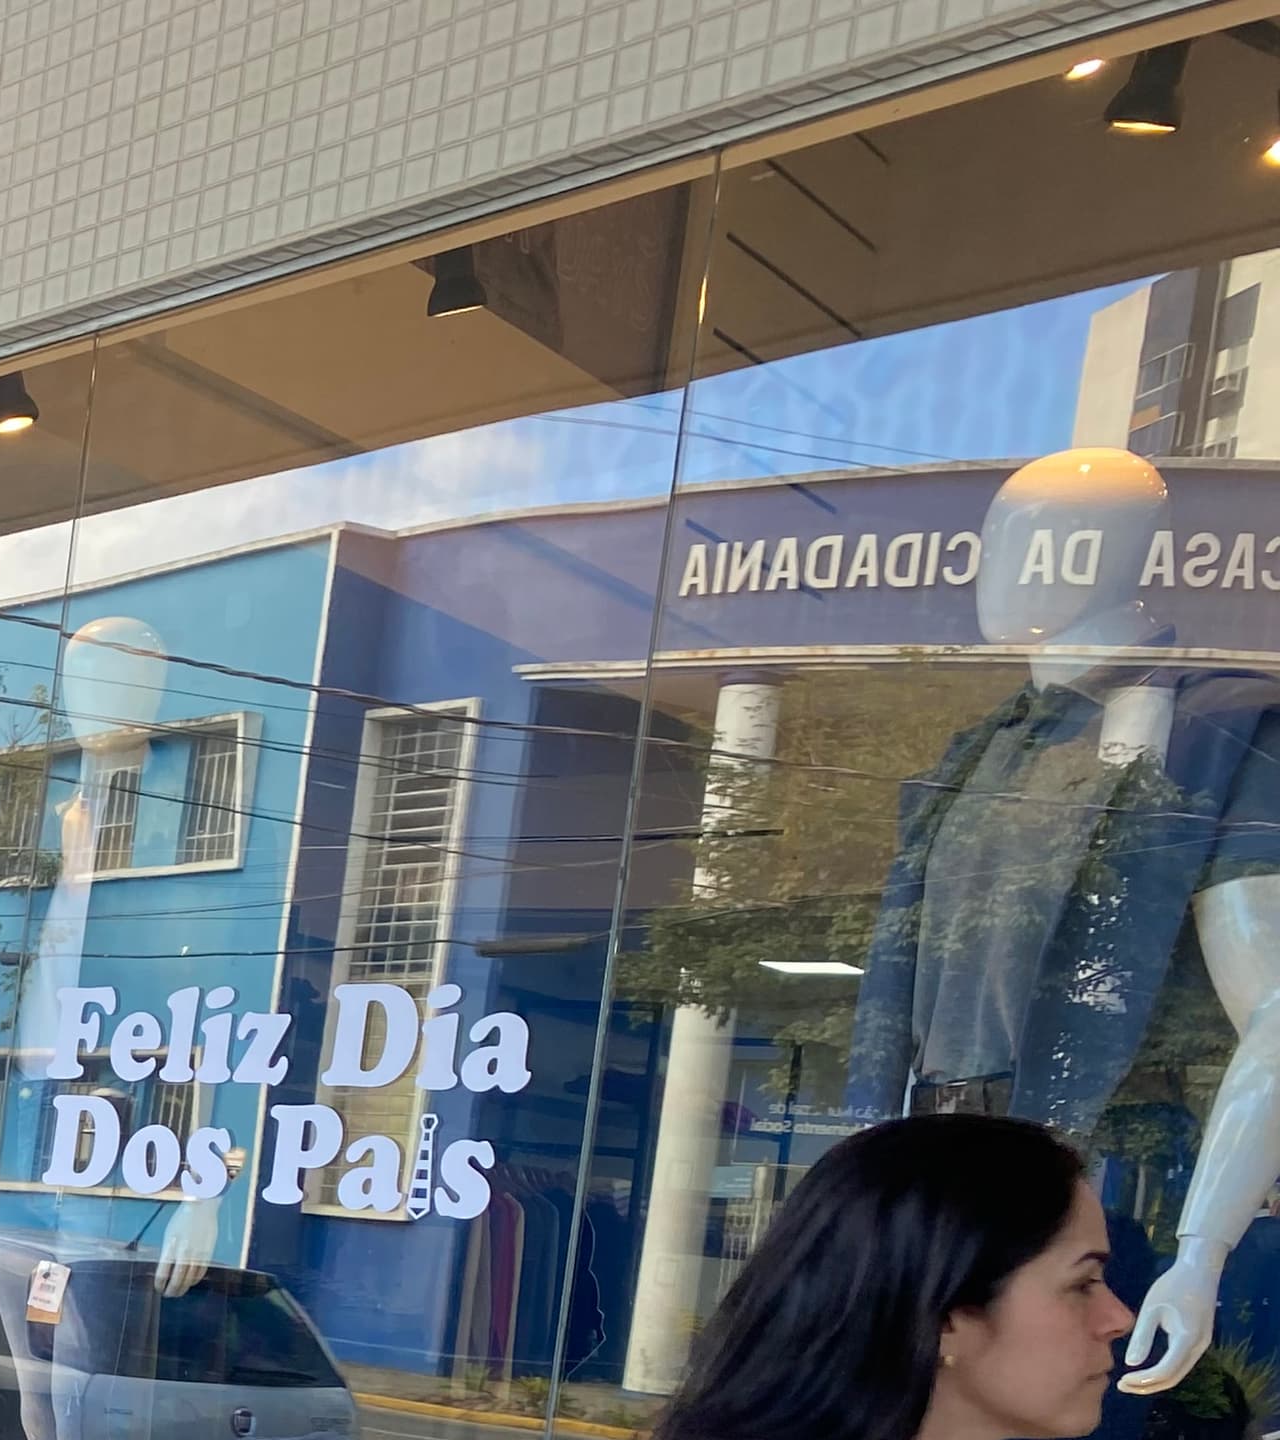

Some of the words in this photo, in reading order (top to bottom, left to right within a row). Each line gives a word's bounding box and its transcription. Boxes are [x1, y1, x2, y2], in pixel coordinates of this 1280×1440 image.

[46, 986, 292, 1087] Feliz
[321, 983, 533, 1094] Dia
[42, 1095, 233, 1200] Dos
[262, 1104, 496, 1220] Pais
